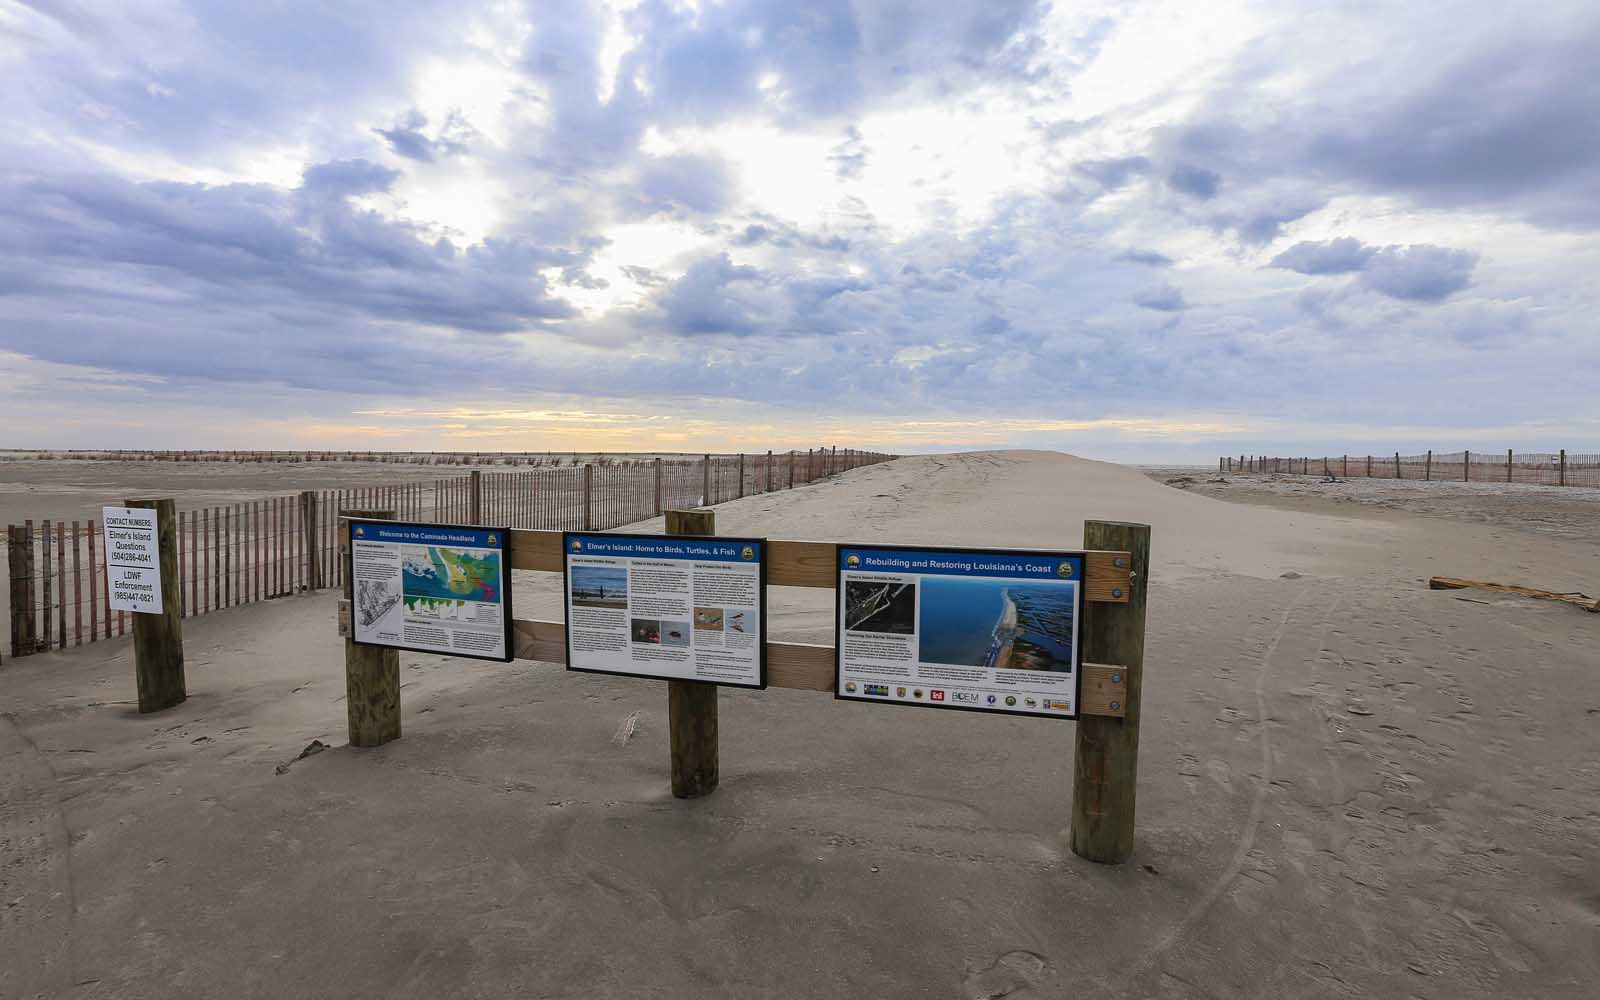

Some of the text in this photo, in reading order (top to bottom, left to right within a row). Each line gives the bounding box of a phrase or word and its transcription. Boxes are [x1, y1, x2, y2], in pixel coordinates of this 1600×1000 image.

[106, 518, 128, 526] CONTACT
[110, 531, 151, 541] Elmer's Island
[116, 542, 146, 551] Questions
[686, 547, 711, 555] Turtles,
[866, 558, 910, 568] Rebuilding
[912, 559, 927, 568] and
[930, 560, 970, 570] Restoring
[973, 563, 1022, 571] Louisiana's
[1025, 564, 1051, 573] Coast
[124, 571, 141, 580] LDWF
[115, 581, 152, 591] Enforcement
